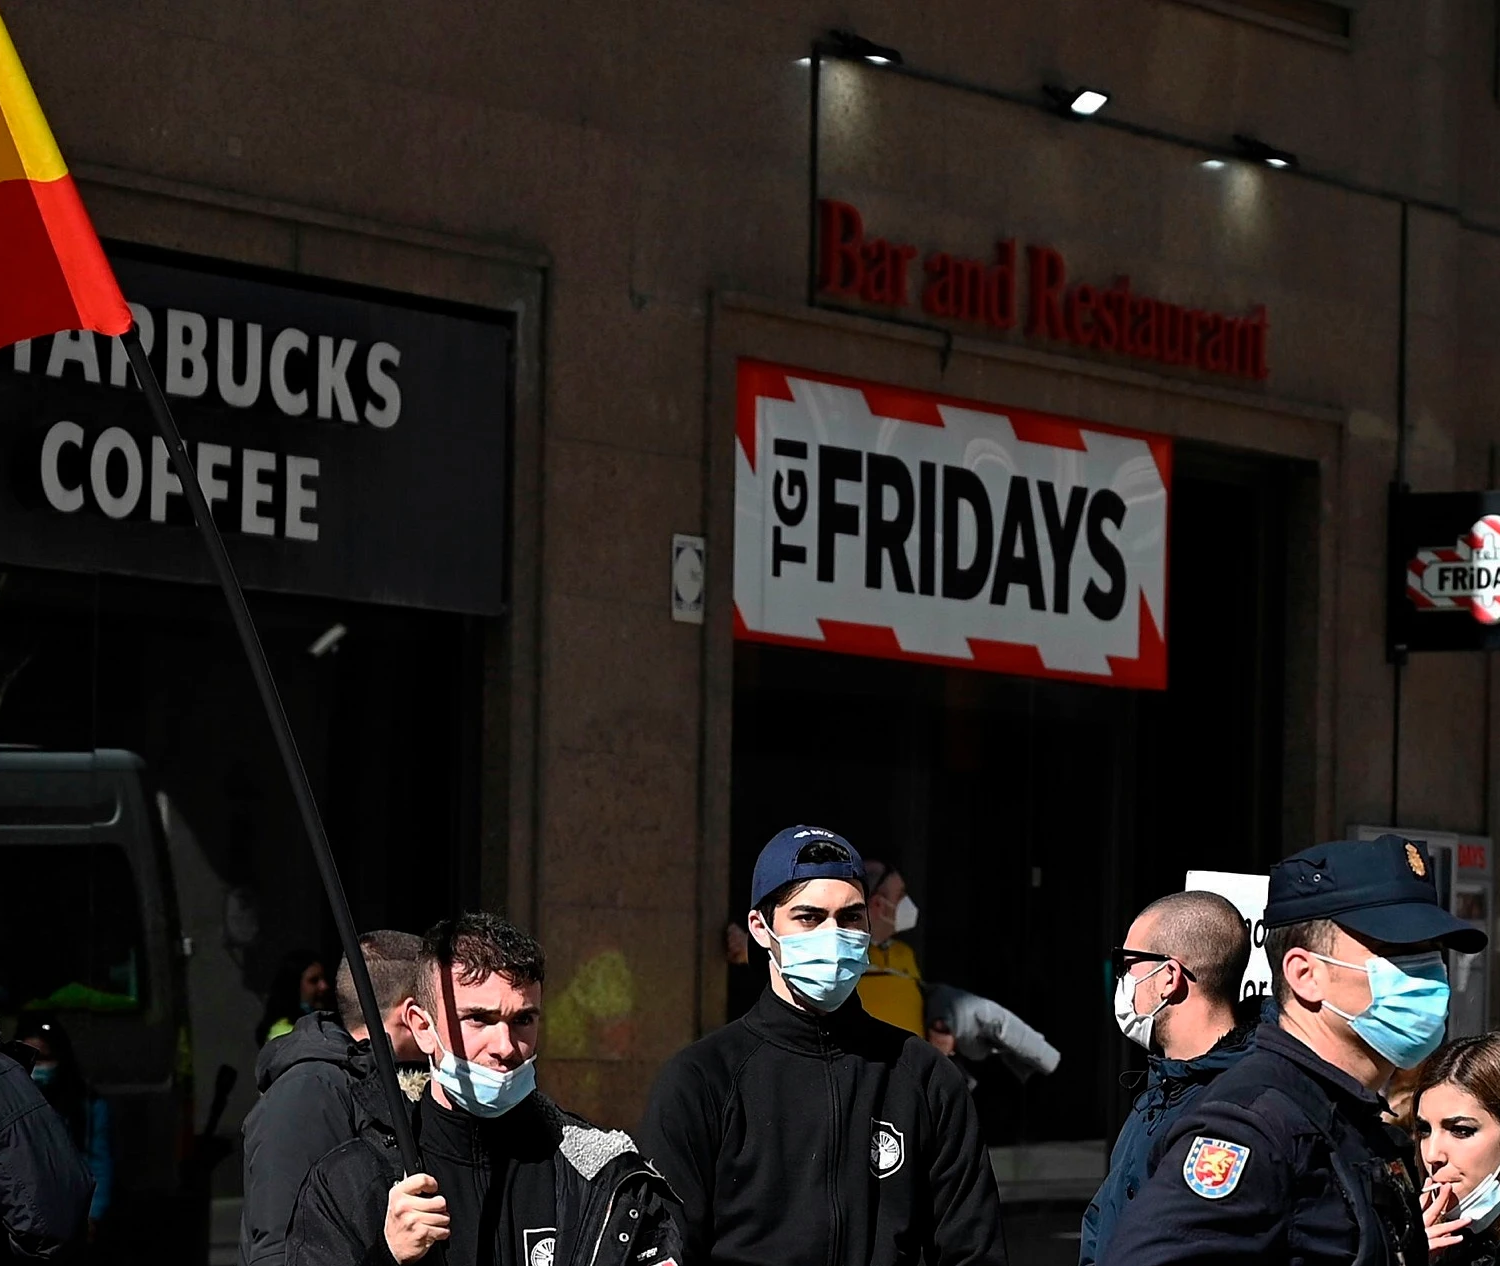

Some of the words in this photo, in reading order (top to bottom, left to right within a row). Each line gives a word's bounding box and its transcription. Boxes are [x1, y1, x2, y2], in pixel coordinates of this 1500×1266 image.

[820, 200, 917, 307] Bar
[924, 228, 1017, 331] and
[1025, 245, 1269, 380] Restaurant
[0, 301, 401, 428] ARBUCKS
[40, 420, 320, 541] COFFEE
[772, 439, 807, 577] TGI
[817, 445, 1127, 621] FRIDAYS
